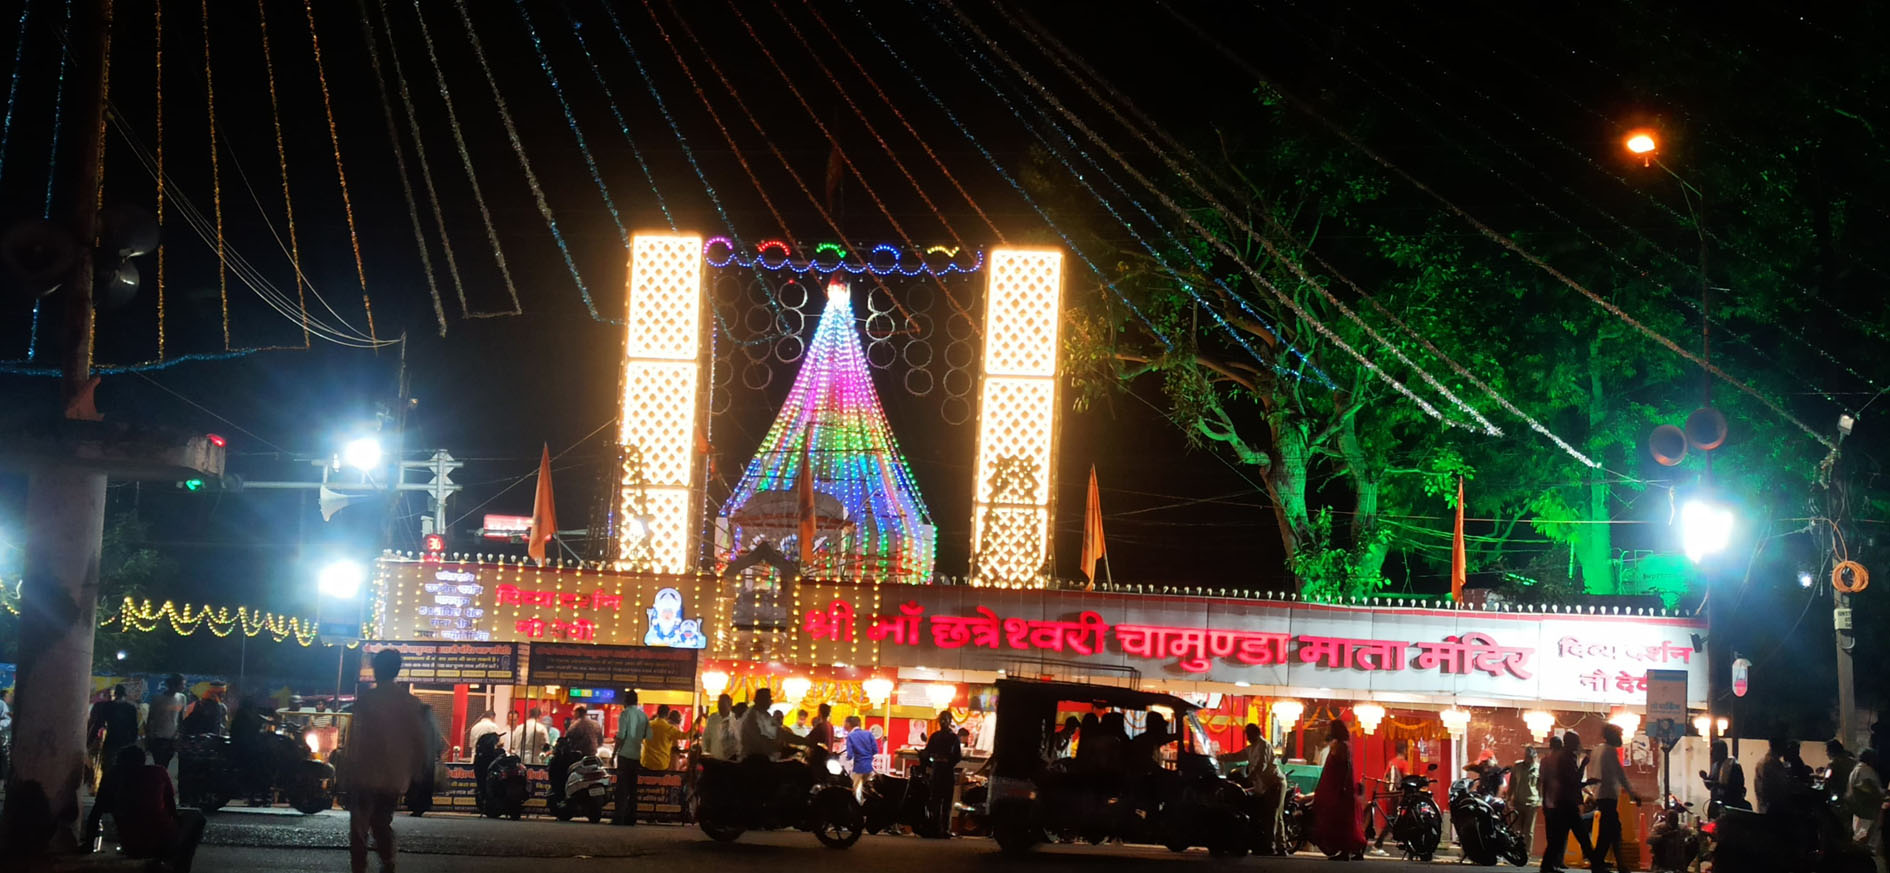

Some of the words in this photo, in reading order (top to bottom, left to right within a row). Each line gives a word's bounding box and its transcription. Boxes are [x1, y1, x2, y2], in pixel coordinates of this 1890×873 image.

[560, 589, 623, 611] दर्शन
[802, 599, 855, 643] श्री
[866, 600, 925, 646] माँ
[931, 606, 1110, 656] छत्रेश्वरी
[1115, 623, 1292, 673] चामुण्डा
[1299, 633, 1411, 672] माता
[1417, 631, 1537, 680] मंदिर
[1579, 668, 1613, 692] नौ
